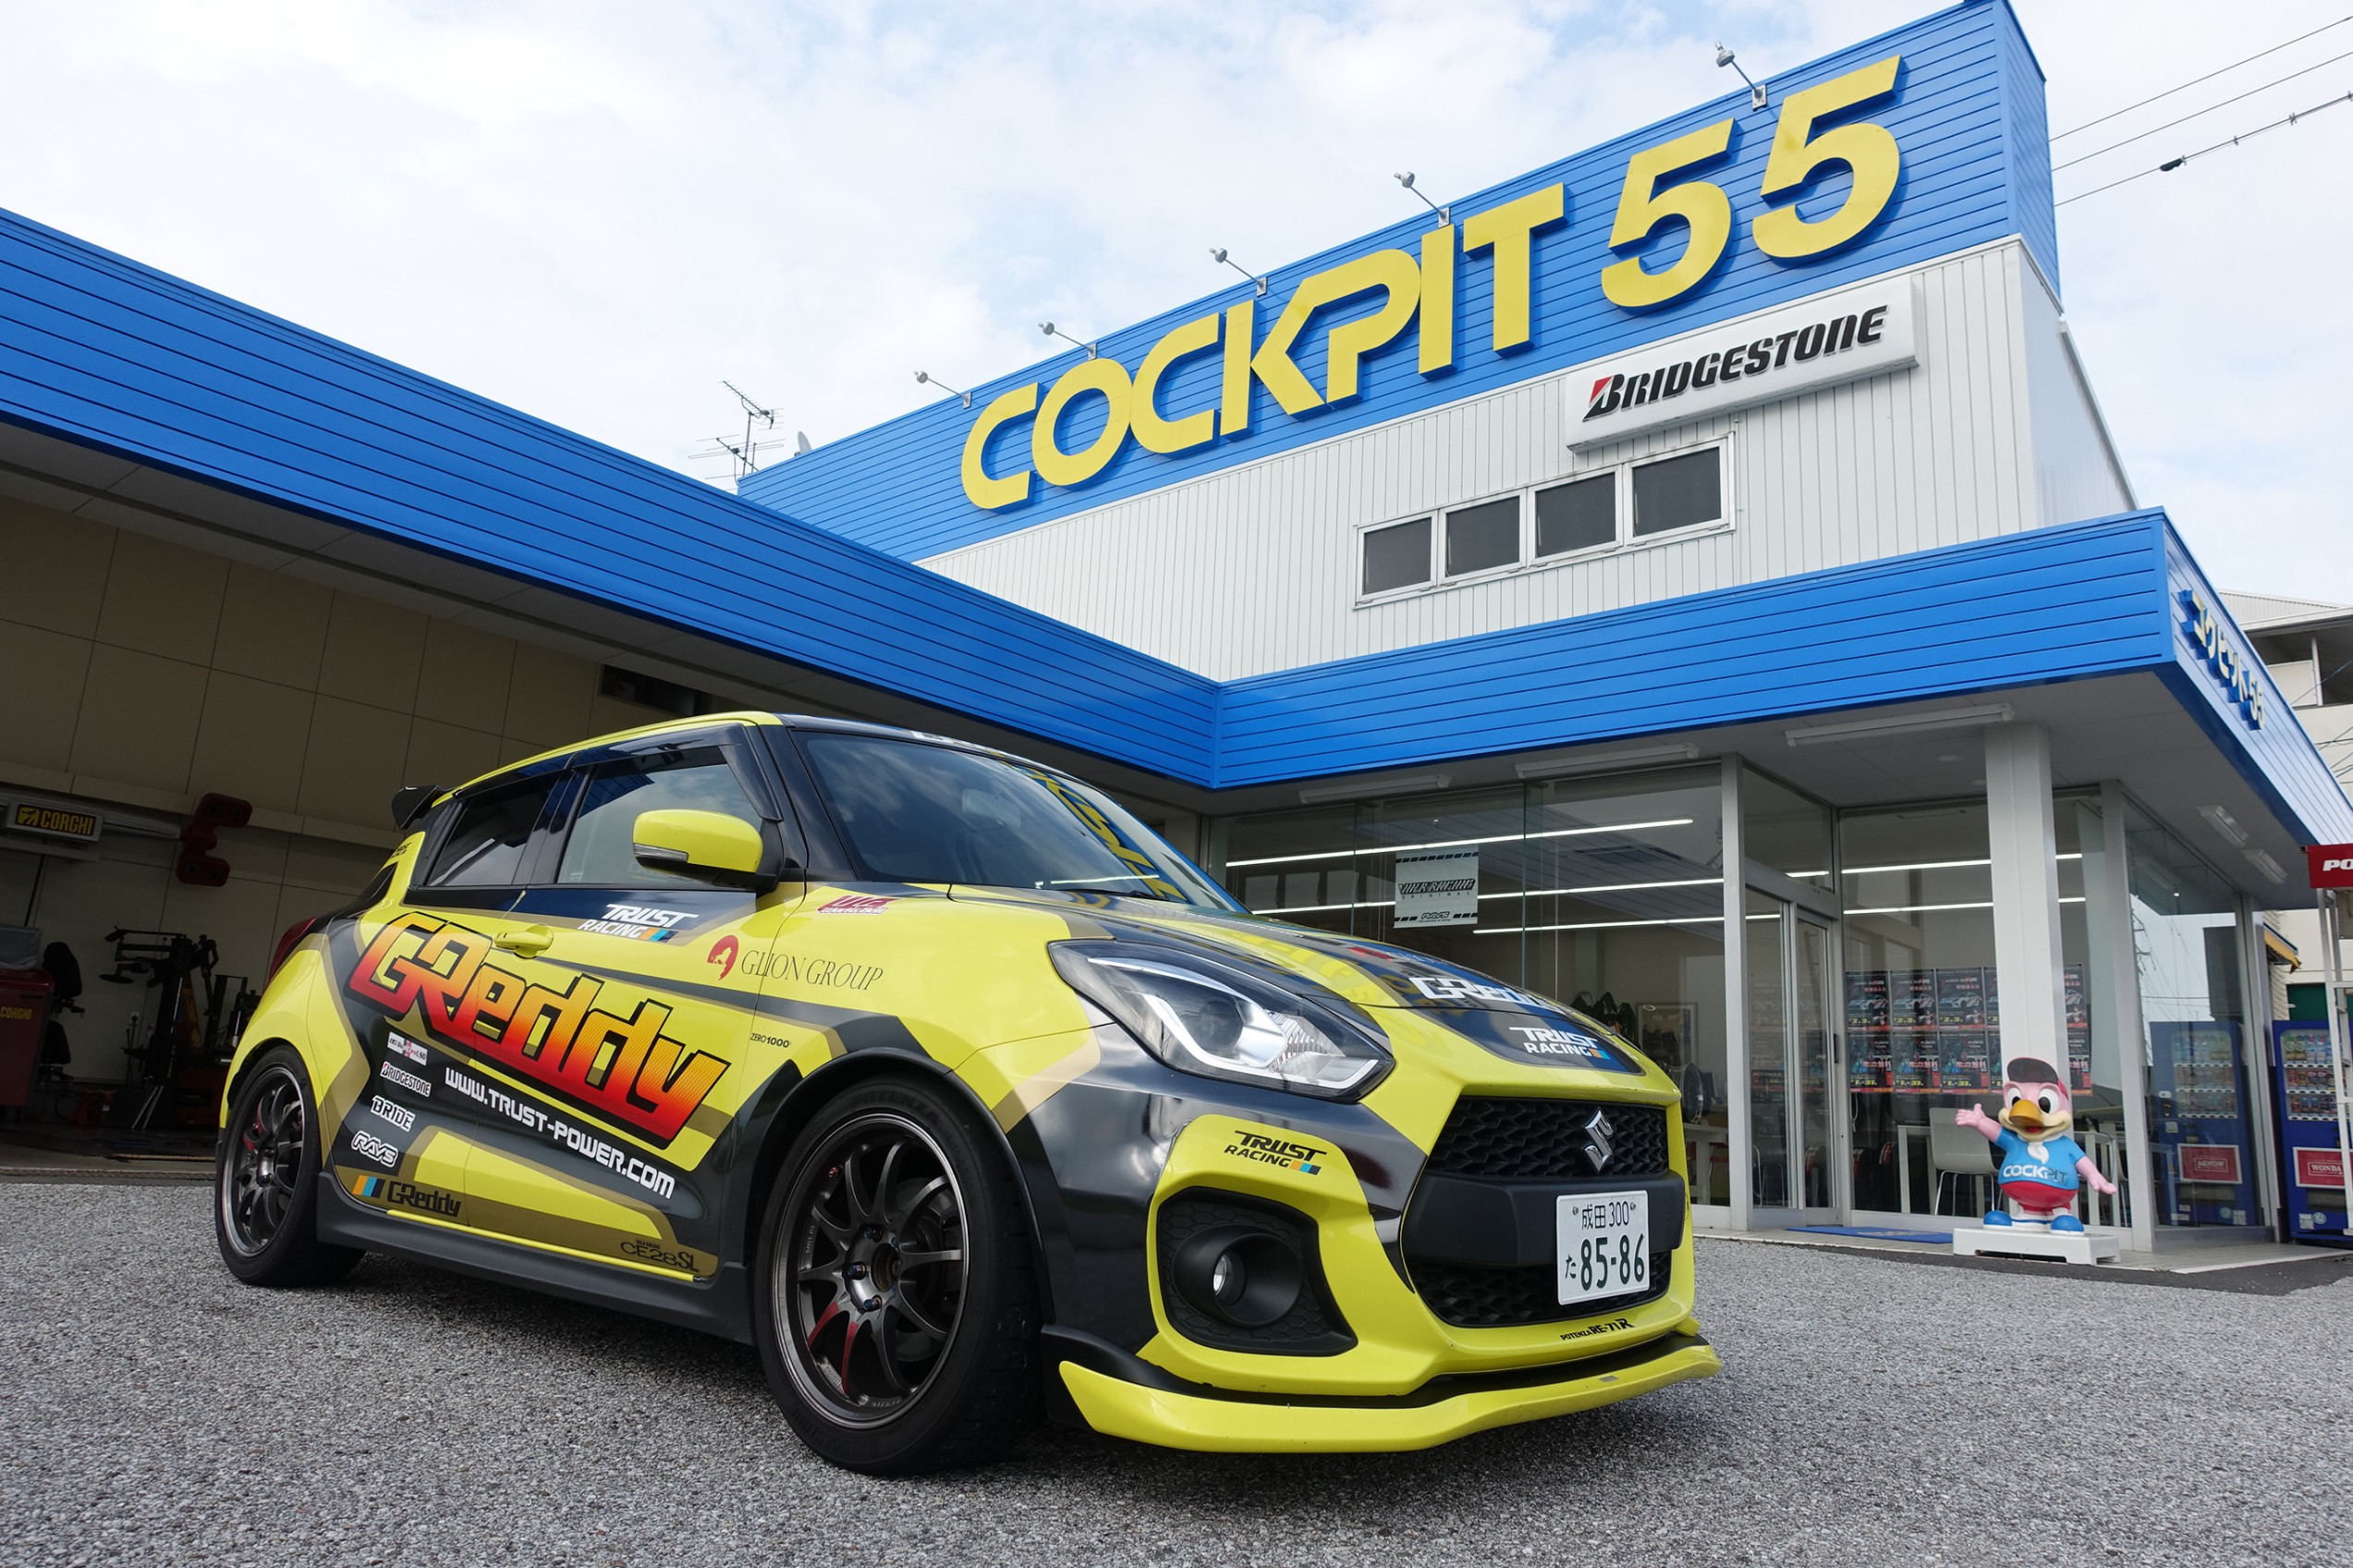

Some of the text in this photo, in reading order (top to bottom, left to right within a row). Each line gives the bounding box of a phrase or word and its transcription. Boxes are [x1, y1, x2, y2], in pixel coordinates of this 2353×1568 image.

[960, 55, 1903, 511] COCKPIT 55
[1581, 305, 1888, 422] BRIDGESTONE
[40, 810, 93, 835] CORGHI
[578, 918, 648, 939] RACING
[602, 904, 700, 928] TRUST
[1420, 911, 1450, 919] RAYS
[741, 949, 884, 991] GLION GROUP
[0, 1006, 33, 1020] CORGHI
[346, 912, 730, 1149] GReddy
[1509, 1027, 1598, 1049] TRUST
[1523, 1042, 1591, 1057] RACING
[381, 1062, 432, 1097] BRIDGESTONE
[372, 1096, 415, 1131] BRIDE
[351, 1131, 398, 1167] RAYS
[1224, 1145, 1292, 1168] RACING
[1235, 1130, 1327, 1161] TRUST
[2003, 1164, 2067, 1185] COCKPIT
[2310, 1164, 2342, 1173] WONDA
[387, 1181, 462, 1217] GReddy
[1581, 1200, 1629, 1231] 成田 300
[1565, 1233, 1645, 1292] た 85-86
[1560, 1318, 1635, 1341] POTENZA RE-71R
